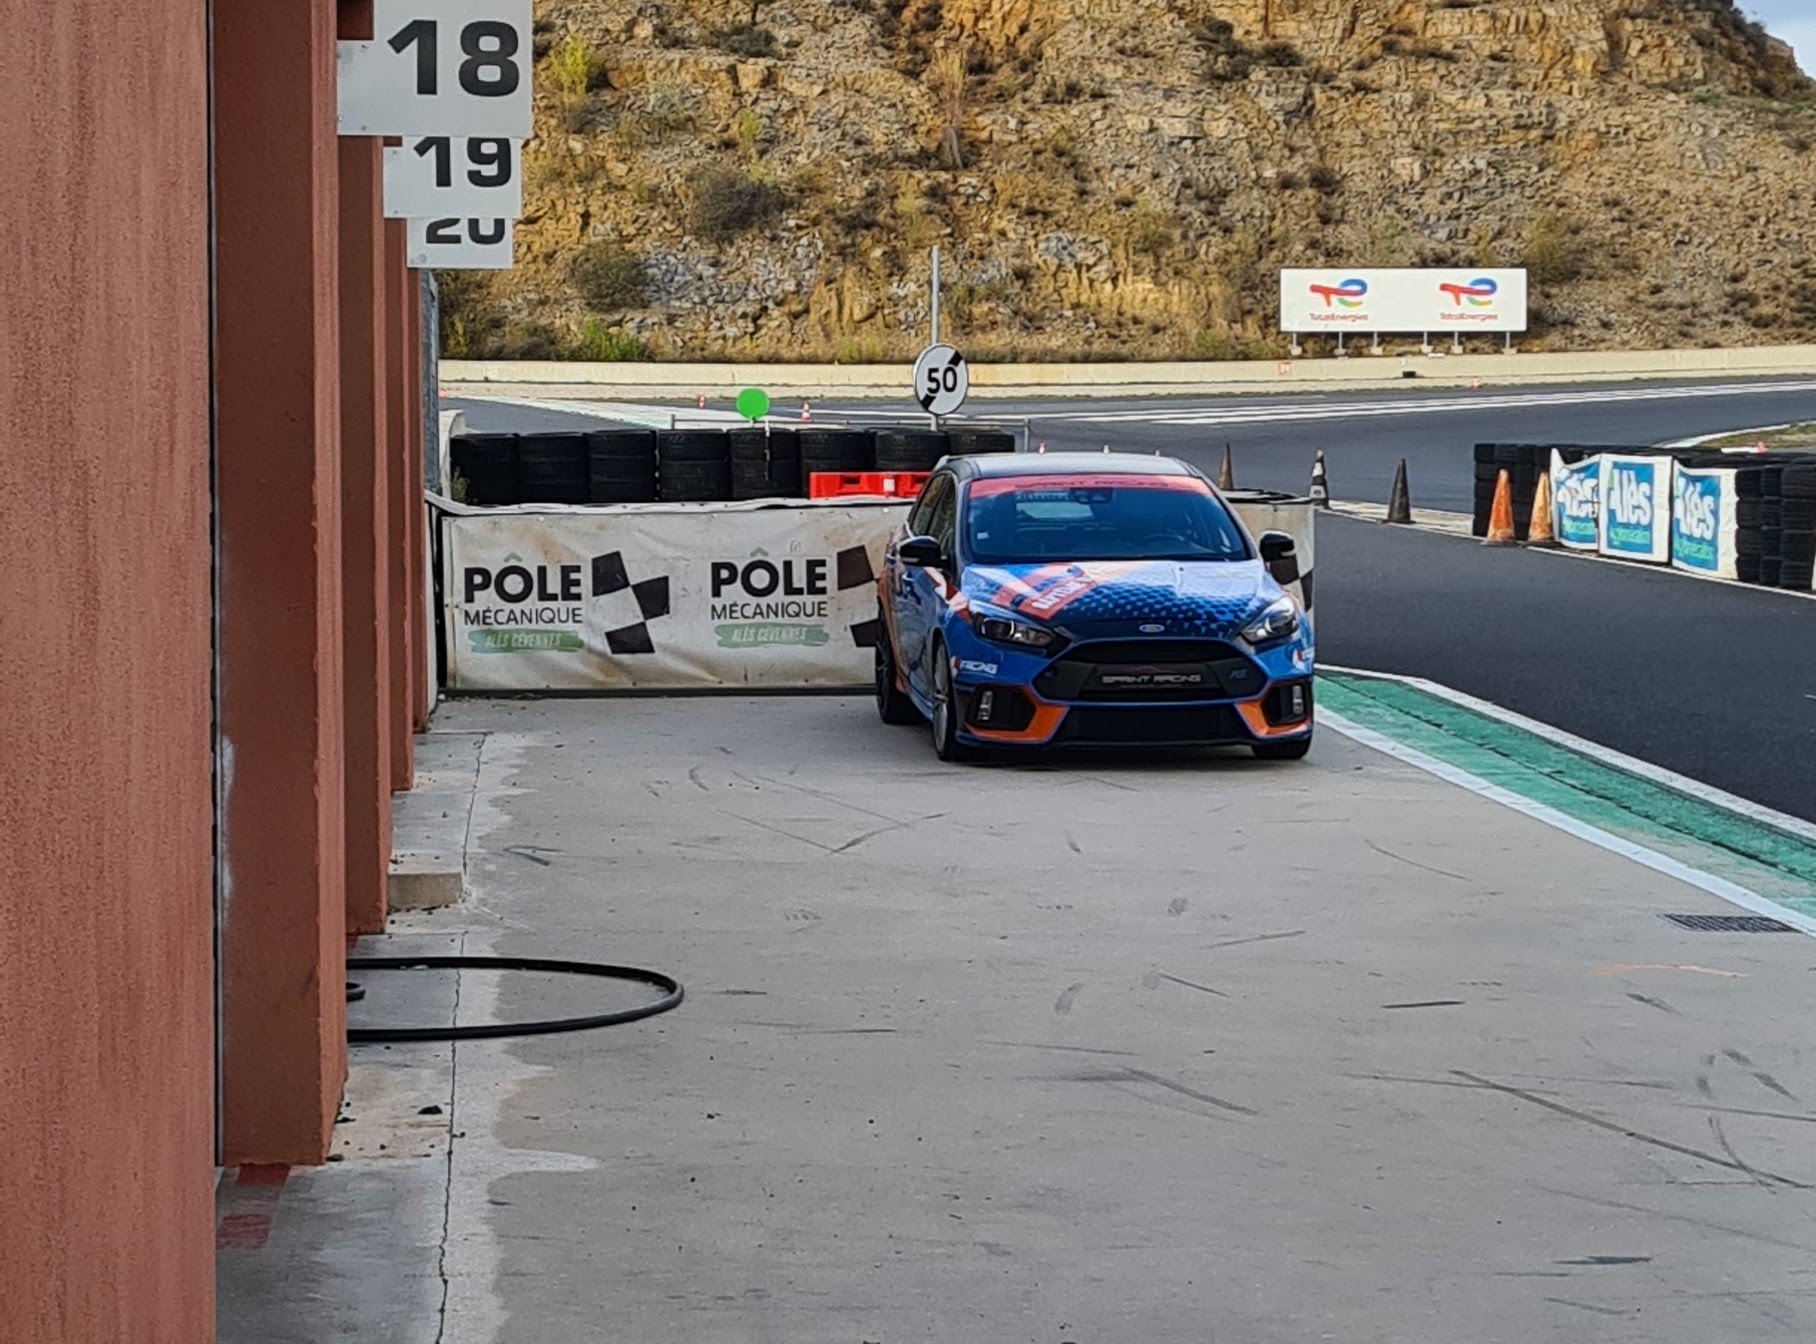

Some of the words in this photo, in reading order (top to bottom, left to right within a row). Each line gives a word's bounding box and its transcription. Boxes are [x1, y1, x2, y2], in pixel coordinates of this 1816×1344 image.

[387, 19, 519, 97] 18
[413, 137, 512, 188] 19
[927, 366, 957, 394] 50
[1610, 469, 1651, 525] Alès
[464, 553, 582, 603] PÔLE
[711, 547, 827, 598] PÔLE
[464, 607, 583, 625] MÉCANIQUE
[711, 601, 828, 620] MÉCANIQUE
